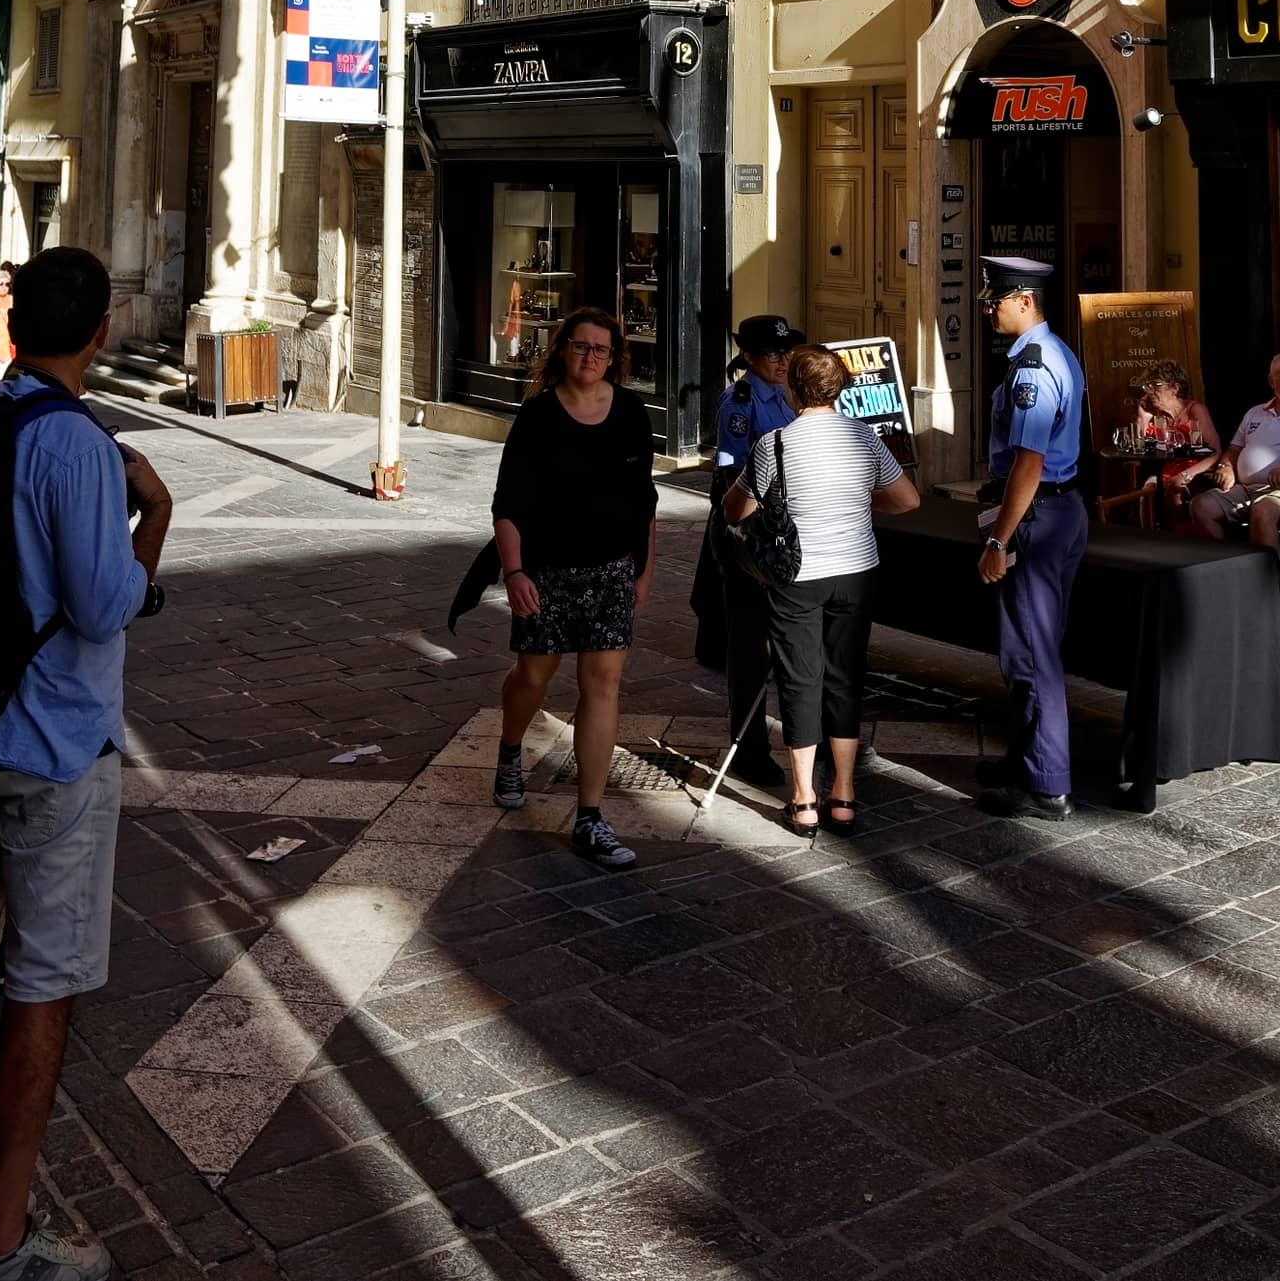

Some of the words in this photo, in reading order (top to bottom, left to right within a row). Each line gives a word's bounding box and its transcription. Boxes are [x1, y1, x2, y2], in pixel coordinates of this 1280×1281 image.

[674, 41, 692, 65] 12
[493, 58, 550, 84] ZAMPA
[985, 75, 1088, 122] rush
[991, 123, 1026, 132] SPORTS
[1028, 123, 1034, 131] &
[1036, 122, 1084, 131] LIFESTYLE
[990, 224, 1018, 243] WE
[1022, 224, 1056, 242] ARE
[1097, 310, 1141, 320] CHARLES
[1144, 309, 1178, 318] GRECH
[1128, 348, 1156, 357] SHOP
[840, 382, 904, 419] SCHOOL
[869, 421, 894, 437] EW
